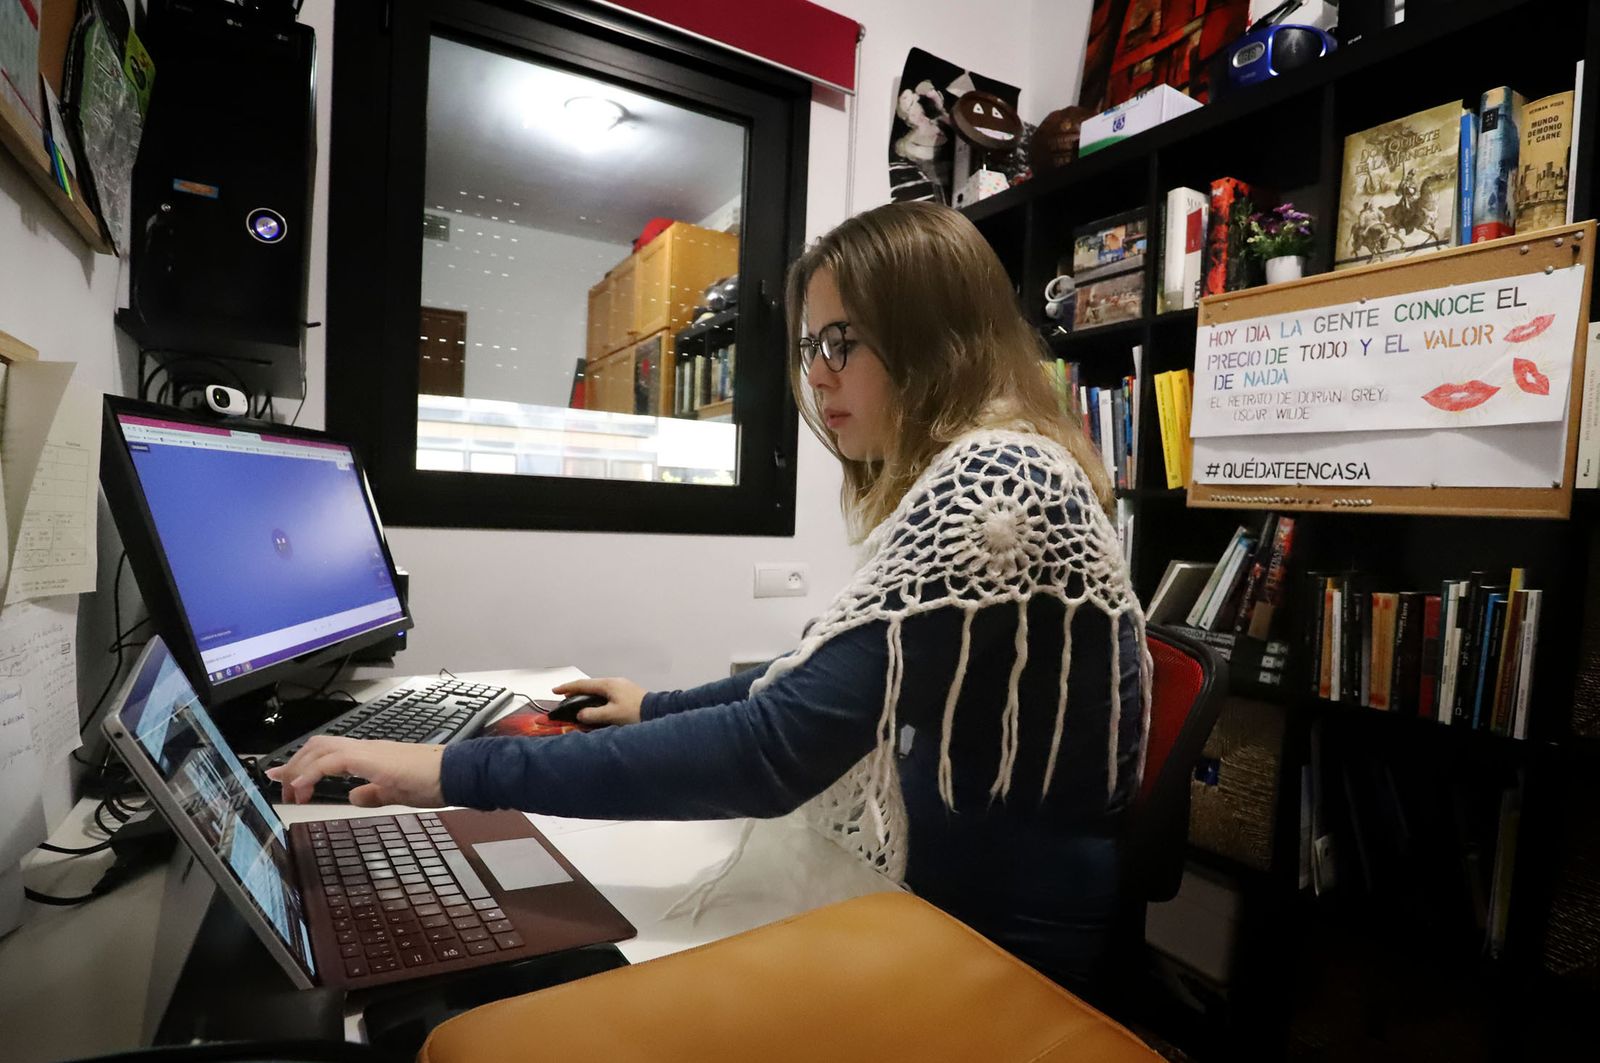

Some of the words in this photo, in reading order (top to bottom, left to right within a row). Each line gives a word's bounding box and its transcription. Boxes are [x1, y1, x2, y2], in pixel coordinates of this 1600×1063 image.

[1527, 122, 1562, 138] DEMONIO
[1531, 115, 1559, 129] MUNDO
[1536, 131, 1561, 143] CARNE
[1209, 328, 1237, 347] HOY
[1280, 319, 1303, 339] LA
[1314, 308, 1379, 334] GENTE
[1394, 292, 1485, 323] CONOCE
[1497, 286, 1527, 310] EL
[1207, 350, 1261, 370] PRECIO
[1265, 347, 1289, 365] DE
[1299, 341, 1347, 362] TODO
[1360, 338, 1372, 356] Y
[1384, 334, 1410, 354] EL
[1423, 324, 1494, 350] VALOR
[1214, 374, 1234, 390] DE
[1243, 368, 1289, 387] NADA
[1210, 396, 1221, 409] EL
[1228, 391, 1272, 408] RETRATO
[1276, 391, 1291, 405] DE
[1298, 390, 1342, 404] DORIAN
[1233, 408, 1267, 422] OSCAR
[1276, 407, 1312, 421] WILDE
